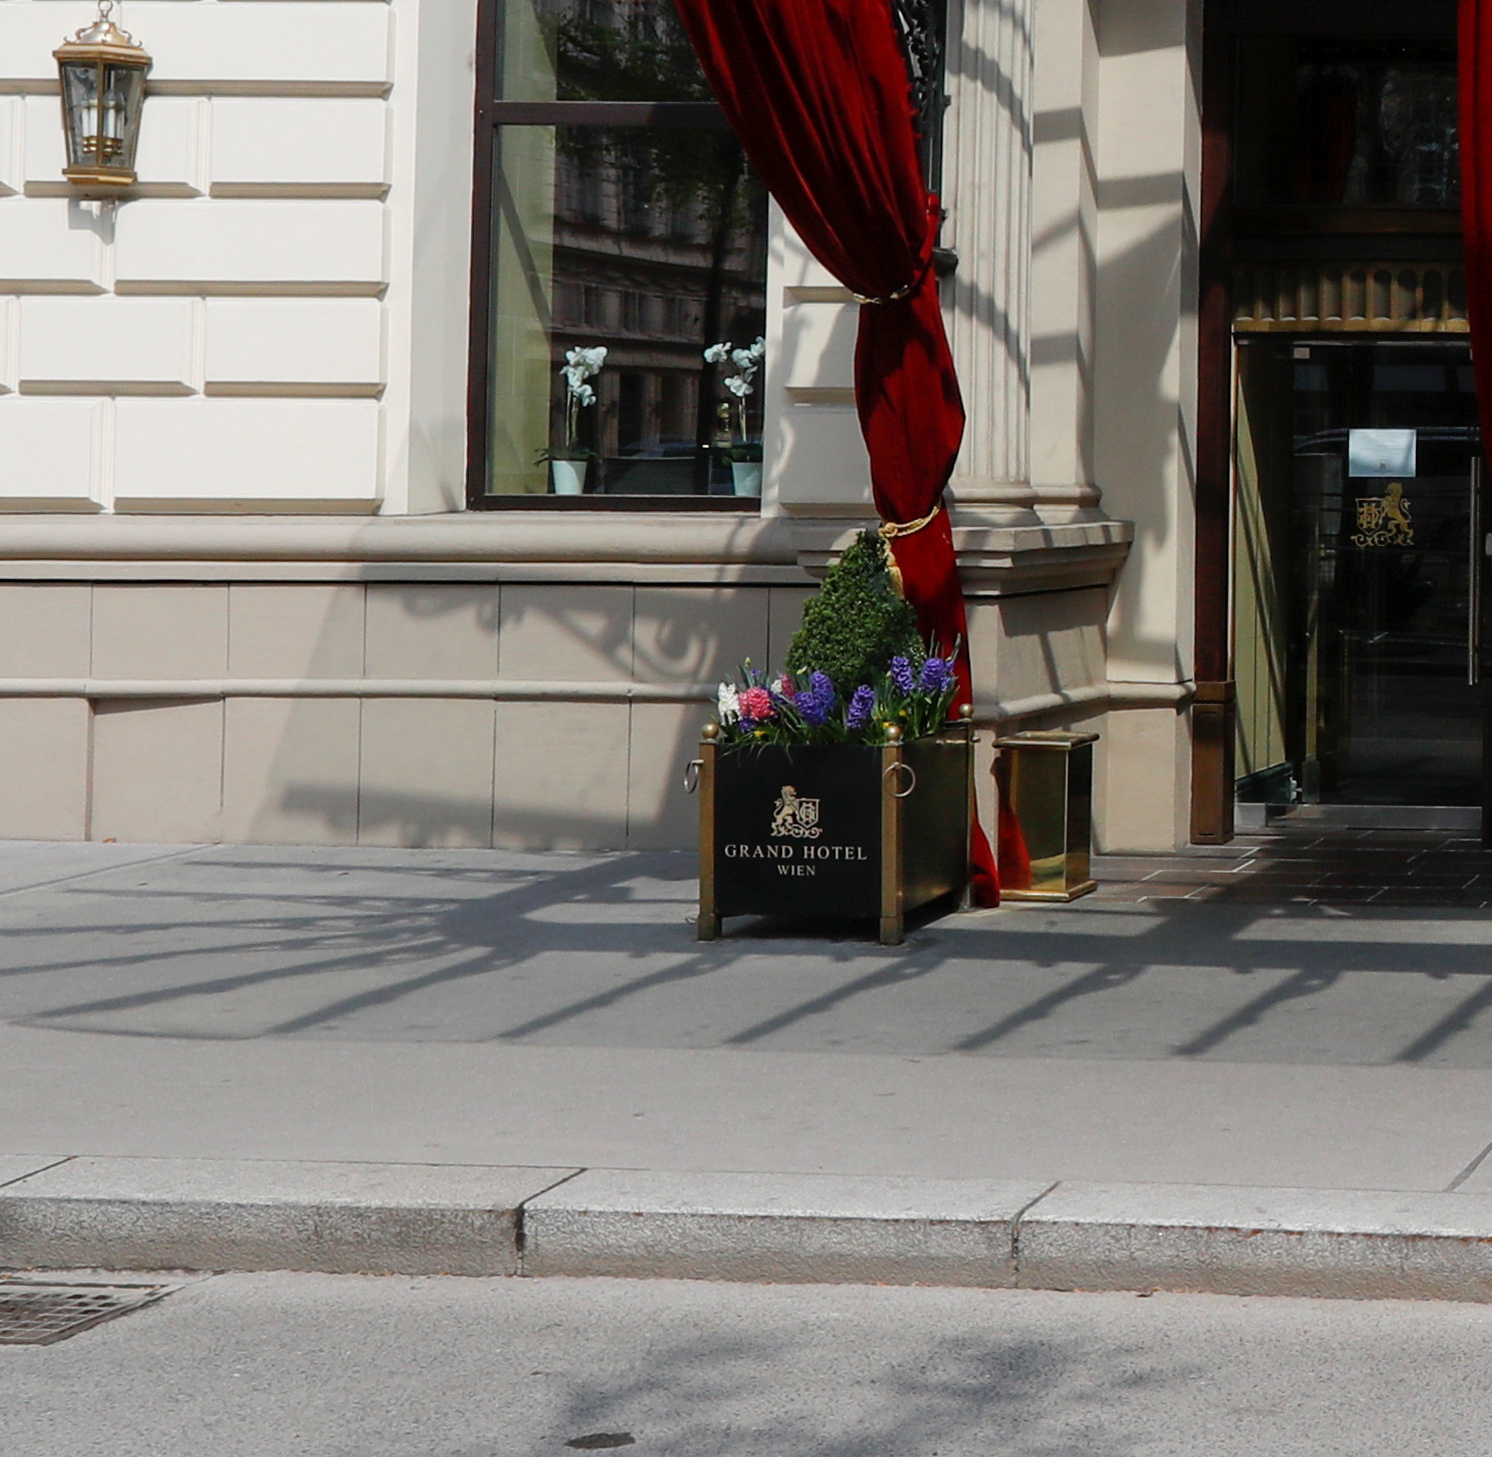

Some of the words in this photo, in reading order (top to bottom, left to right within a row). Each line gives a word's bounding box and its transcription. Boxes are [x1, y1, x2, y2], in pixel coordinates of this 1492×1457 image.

[724, 844, 794, 859] GRAND
[803, 845, 868, 861] HOTEL
[777, 864, 816, 876] WIEN
